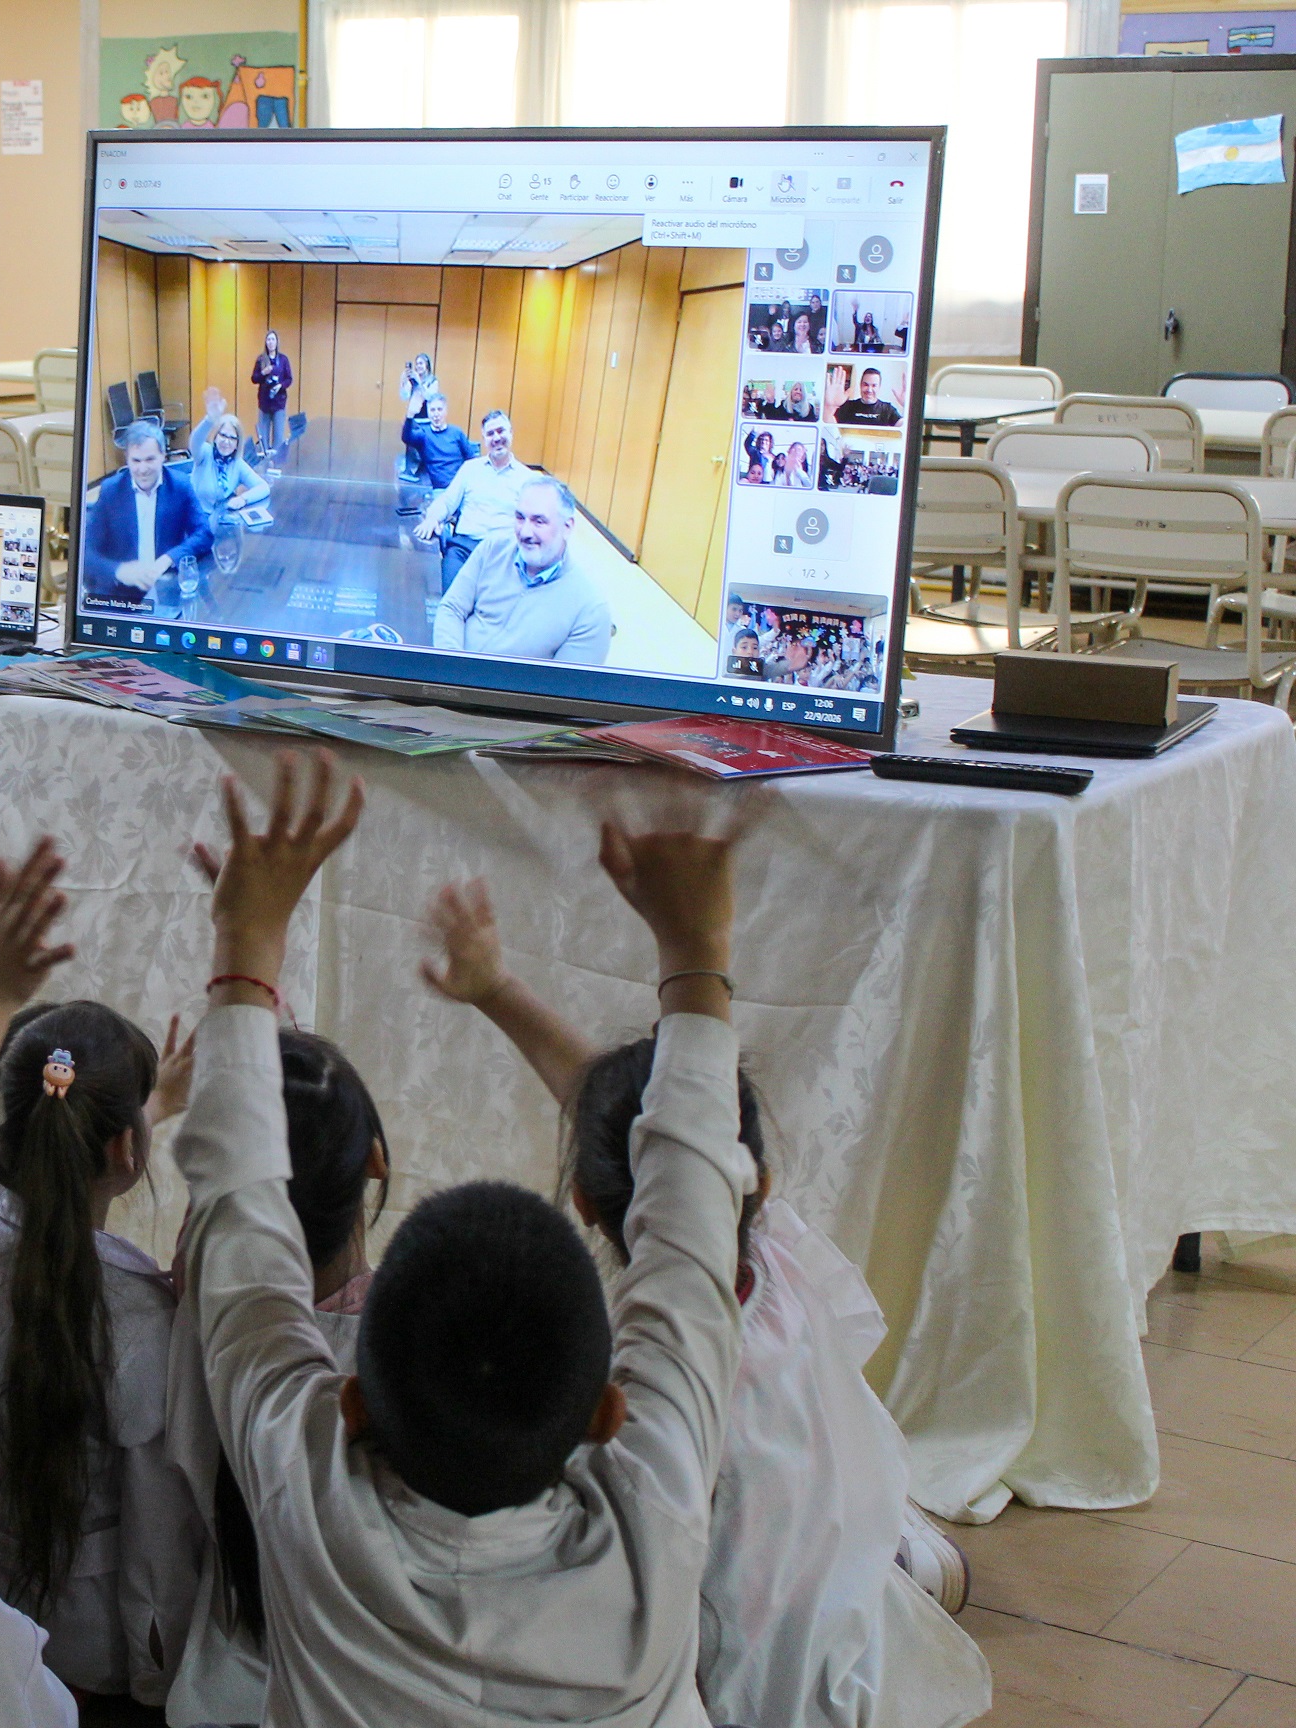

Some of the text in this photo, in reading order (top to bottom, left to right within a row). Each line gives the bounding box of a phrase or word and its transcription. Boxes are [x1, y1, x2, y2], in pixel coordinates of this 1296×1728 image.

[100, 150, 128, 158] ENACOM
[543, 177, 552, 186] 15
[497, 193, 512, 201] Chat
[530, 193, 549, 201] Gente
[560, 193, 589, 202] Participar
[595, 194, 629, 202] Reaccionar
[644, 194, 656, 202] Ver
[722, 194, 747, 203] Cámara
[771, 195, 806, 204] Micrófono
[888, 196, 903, 205] Salir
[651, 219, 757, 229] Reactivar audio del micrófono
[650, 231, 702, 241] (Ctrl+Shift+M)
[802, 568, 816, 578] 1/2
[781, 701, 797, 711] ESP
